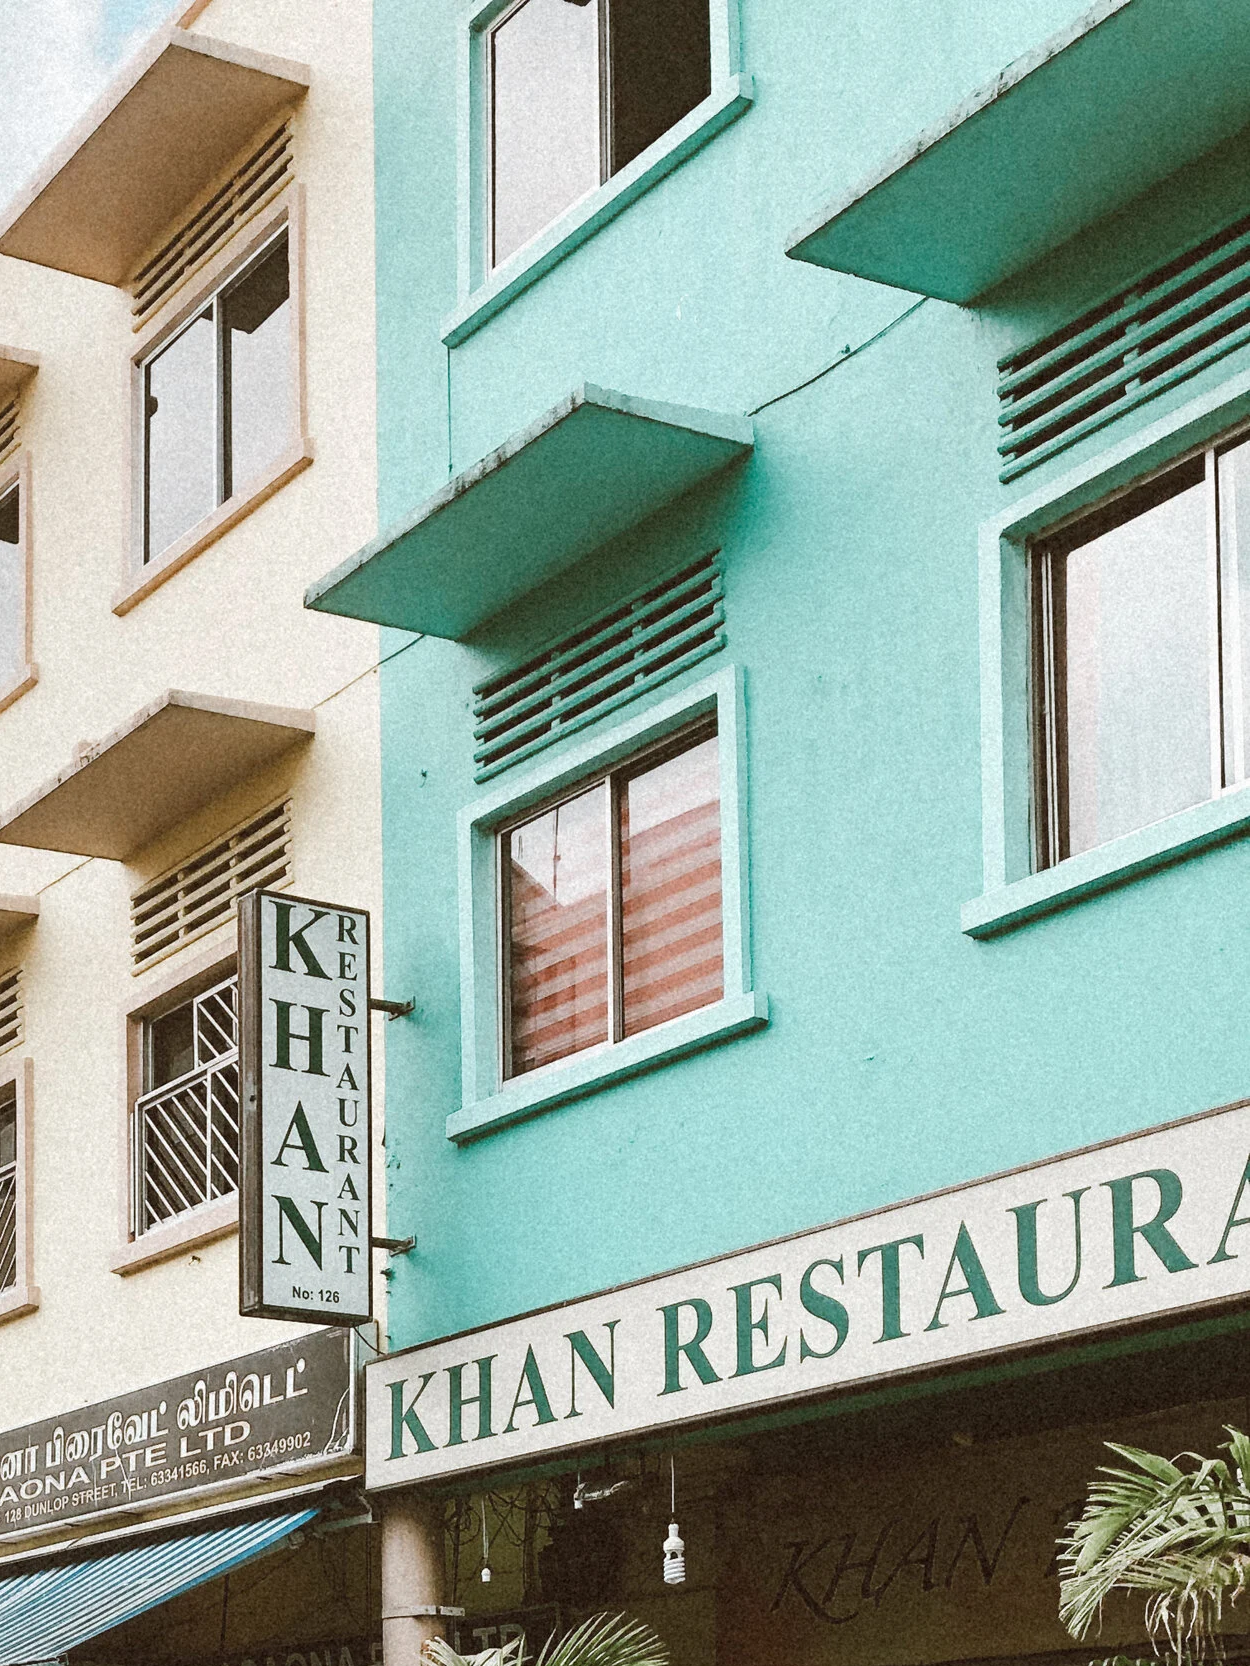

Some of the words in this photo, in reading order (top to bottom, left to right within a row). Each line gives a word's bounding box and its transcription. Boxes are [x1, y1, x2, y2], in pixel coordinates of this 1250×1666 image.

[268, 899, 333, 1272] KHAN
[335, 912, 361, 1275] RESTAURANT
[291, 1285, 314, 1301] No:
[317, 1288, 341, 1304] 126
[384, 1318, 622, 1462] KHAN
[4, 1509, 22, 1524] 128
[24, 1496, 69, 1520] DUNLOP
[213, 1452, 244, 1471] FAX:
[100, 1442, 167, 1480] PTE
[179, 1420, 252, 1459] LTD
